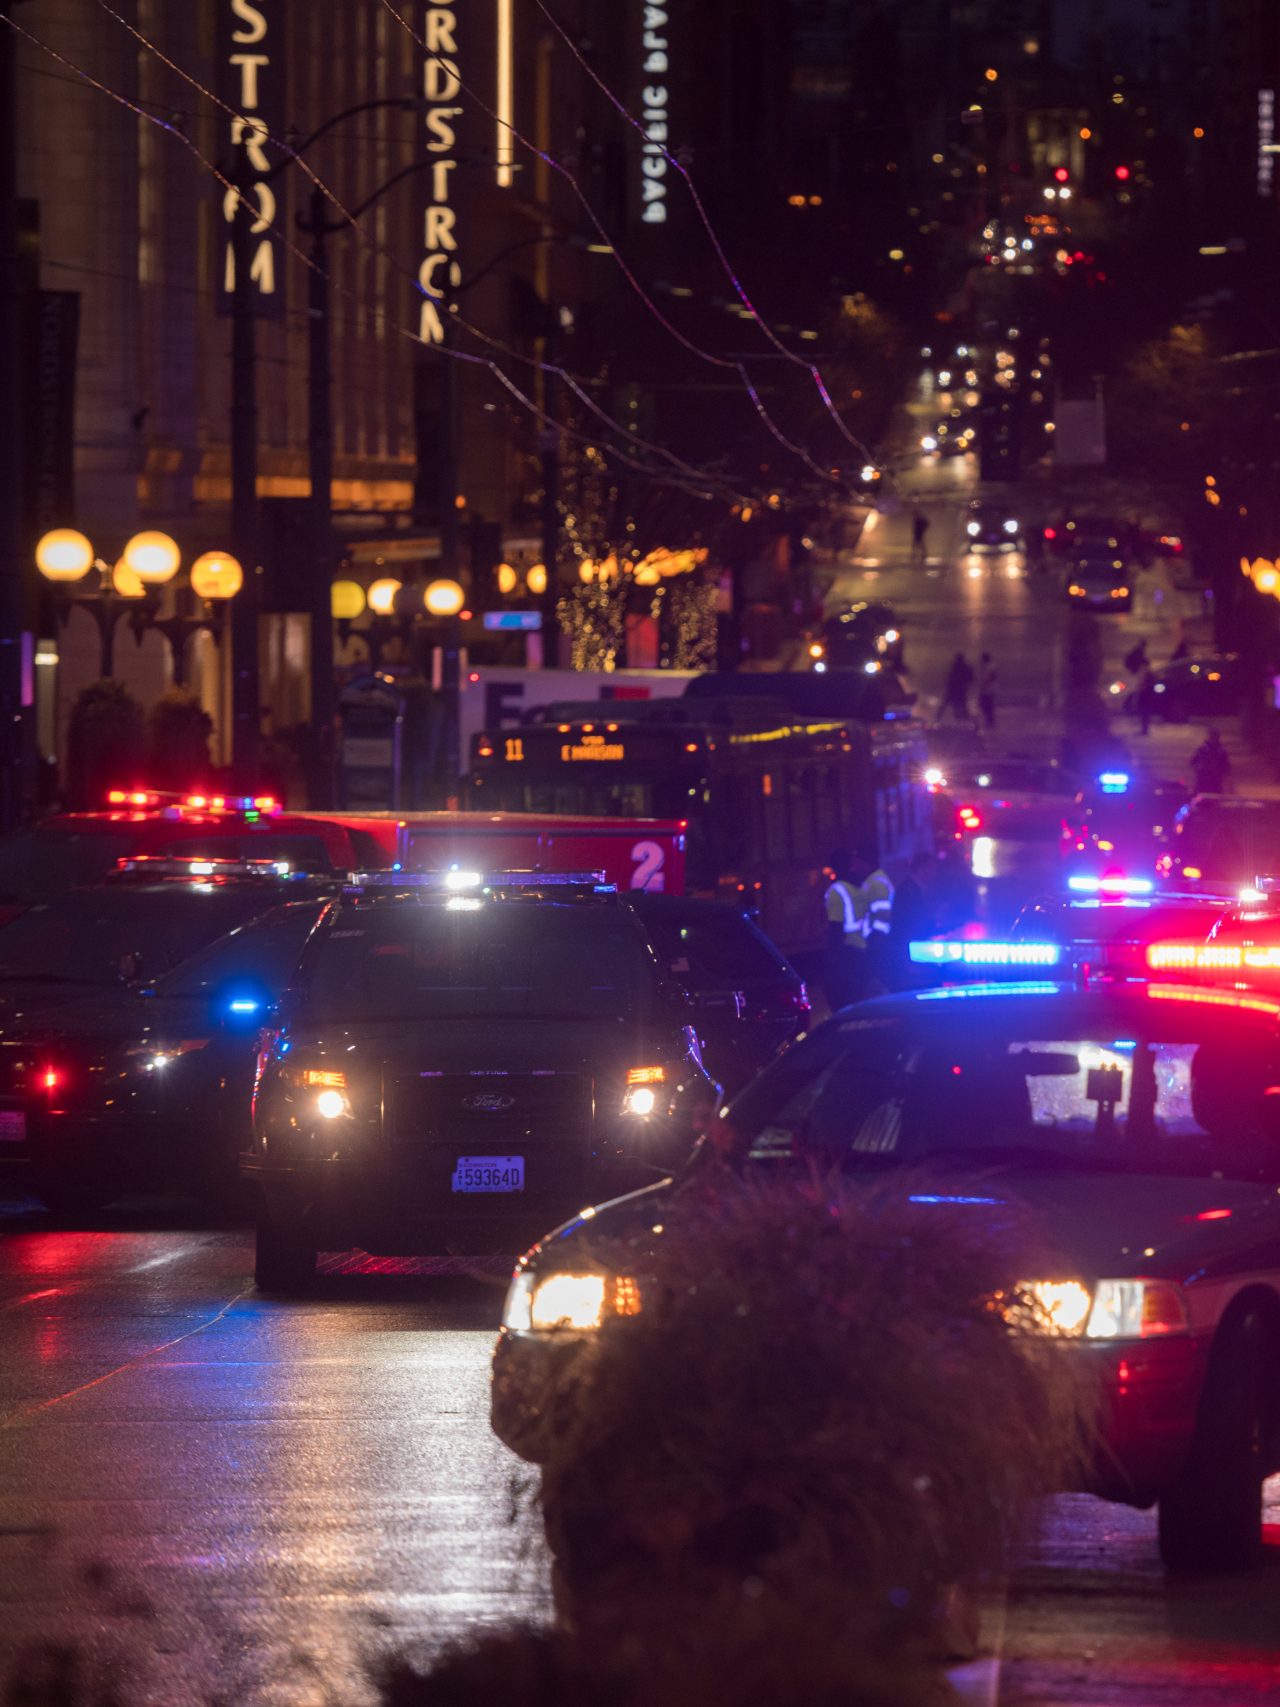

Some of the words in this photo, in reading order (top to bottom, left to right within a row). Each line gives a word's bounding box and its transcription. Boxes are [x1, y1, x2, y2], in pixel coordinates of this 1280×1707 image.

[642, 0, 669, 73] PLA
[641, 85, 668, 224] PACIFIC
[505, 738, 524, 761] 11
[630, 840, 665, 892] 2
[464, 1168, 520, 1186] 59364D
